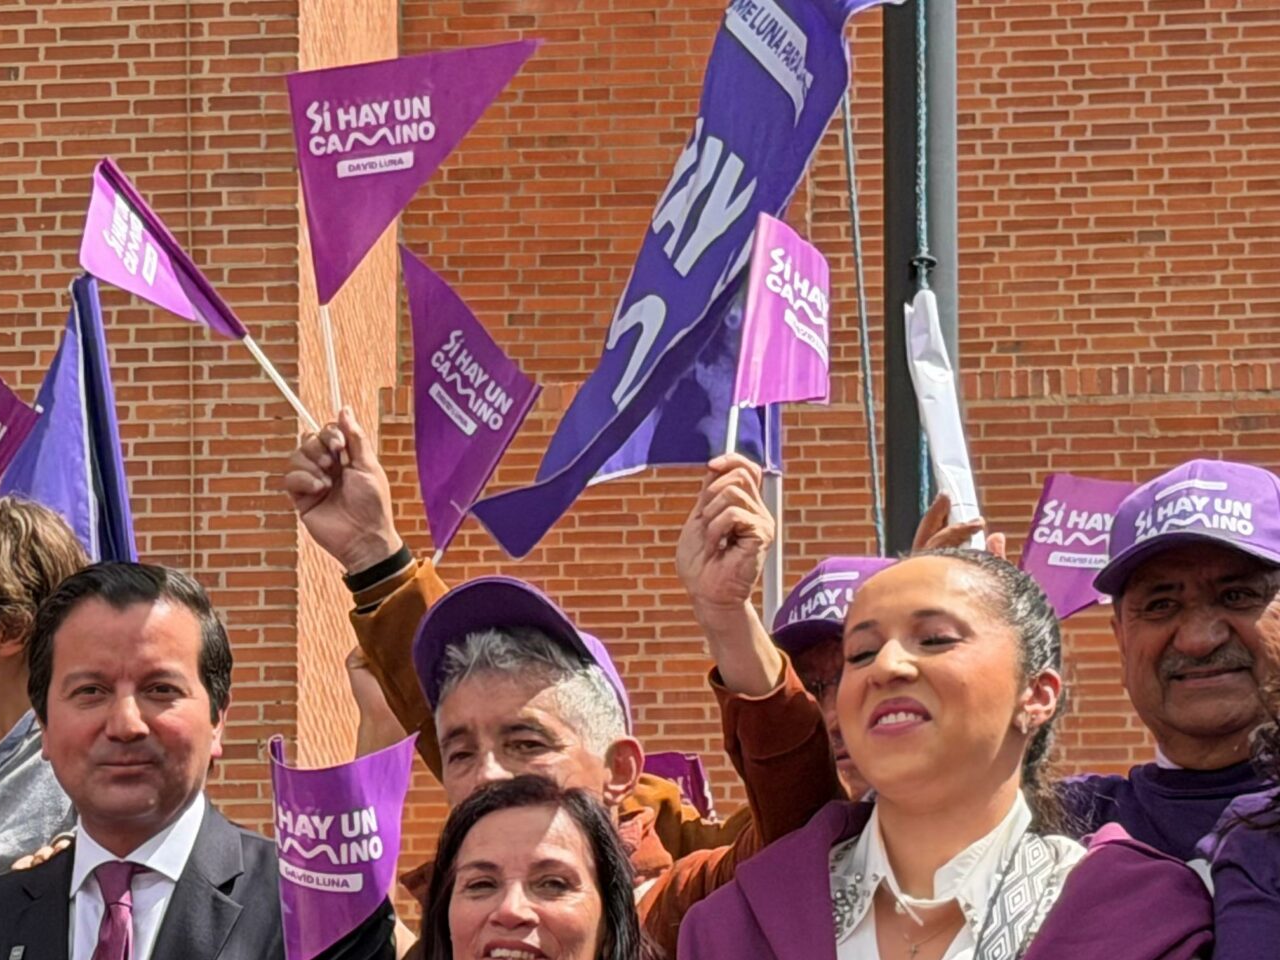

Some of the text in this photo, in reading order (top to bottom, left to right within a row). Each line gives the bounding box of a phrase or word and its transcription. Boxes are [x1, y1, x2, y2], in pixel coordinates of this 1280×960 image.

[749, 6, 788, 58] LUNA
[336, 101, 389, 131] HAY
[394, 95, 431, 121] UN
[309, 120, 436, 156] CAMINO
[347, 157, 405, 173] DAVID LUNA
[430, 350, 504, 431] CAMINO
[454, 348, 490, 389] HAY
[484, 379, 514, 416] UN
[1066, 509, 1115, 532] HAY
[1157, 495, 1211, 522] HAY
[1213, 497, 1253, 519] UN
[801, 588, 842, 620] HAY
[277, 804, 379, 840] HAY UN
[316, 876, 350, 889] LUNA
